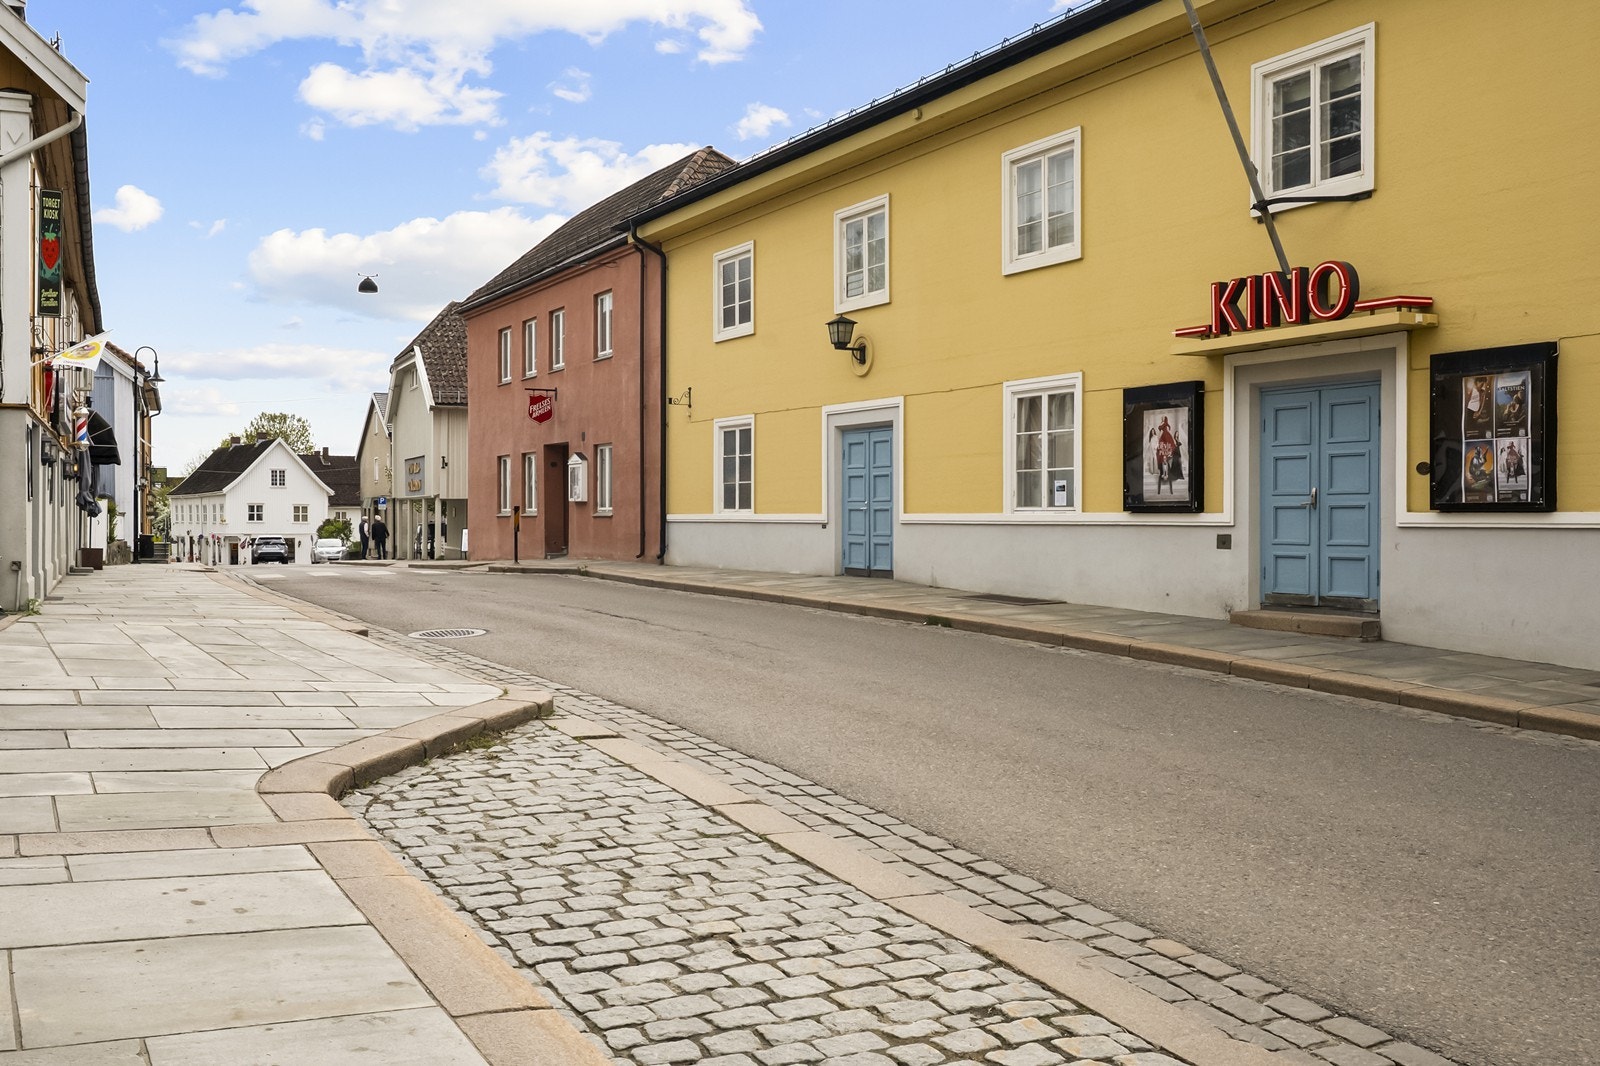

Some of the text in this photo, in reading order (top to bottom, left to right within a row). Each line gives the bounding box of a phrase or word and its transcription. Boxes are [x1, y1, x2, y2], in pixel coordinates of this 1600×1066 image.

[43, 197, 60, 209] TORGET
[43, 209, 59, 220] KIOSK
[1211, 261, 1359, 335] KINO
[530, 397, 551, 414] FRELSES
